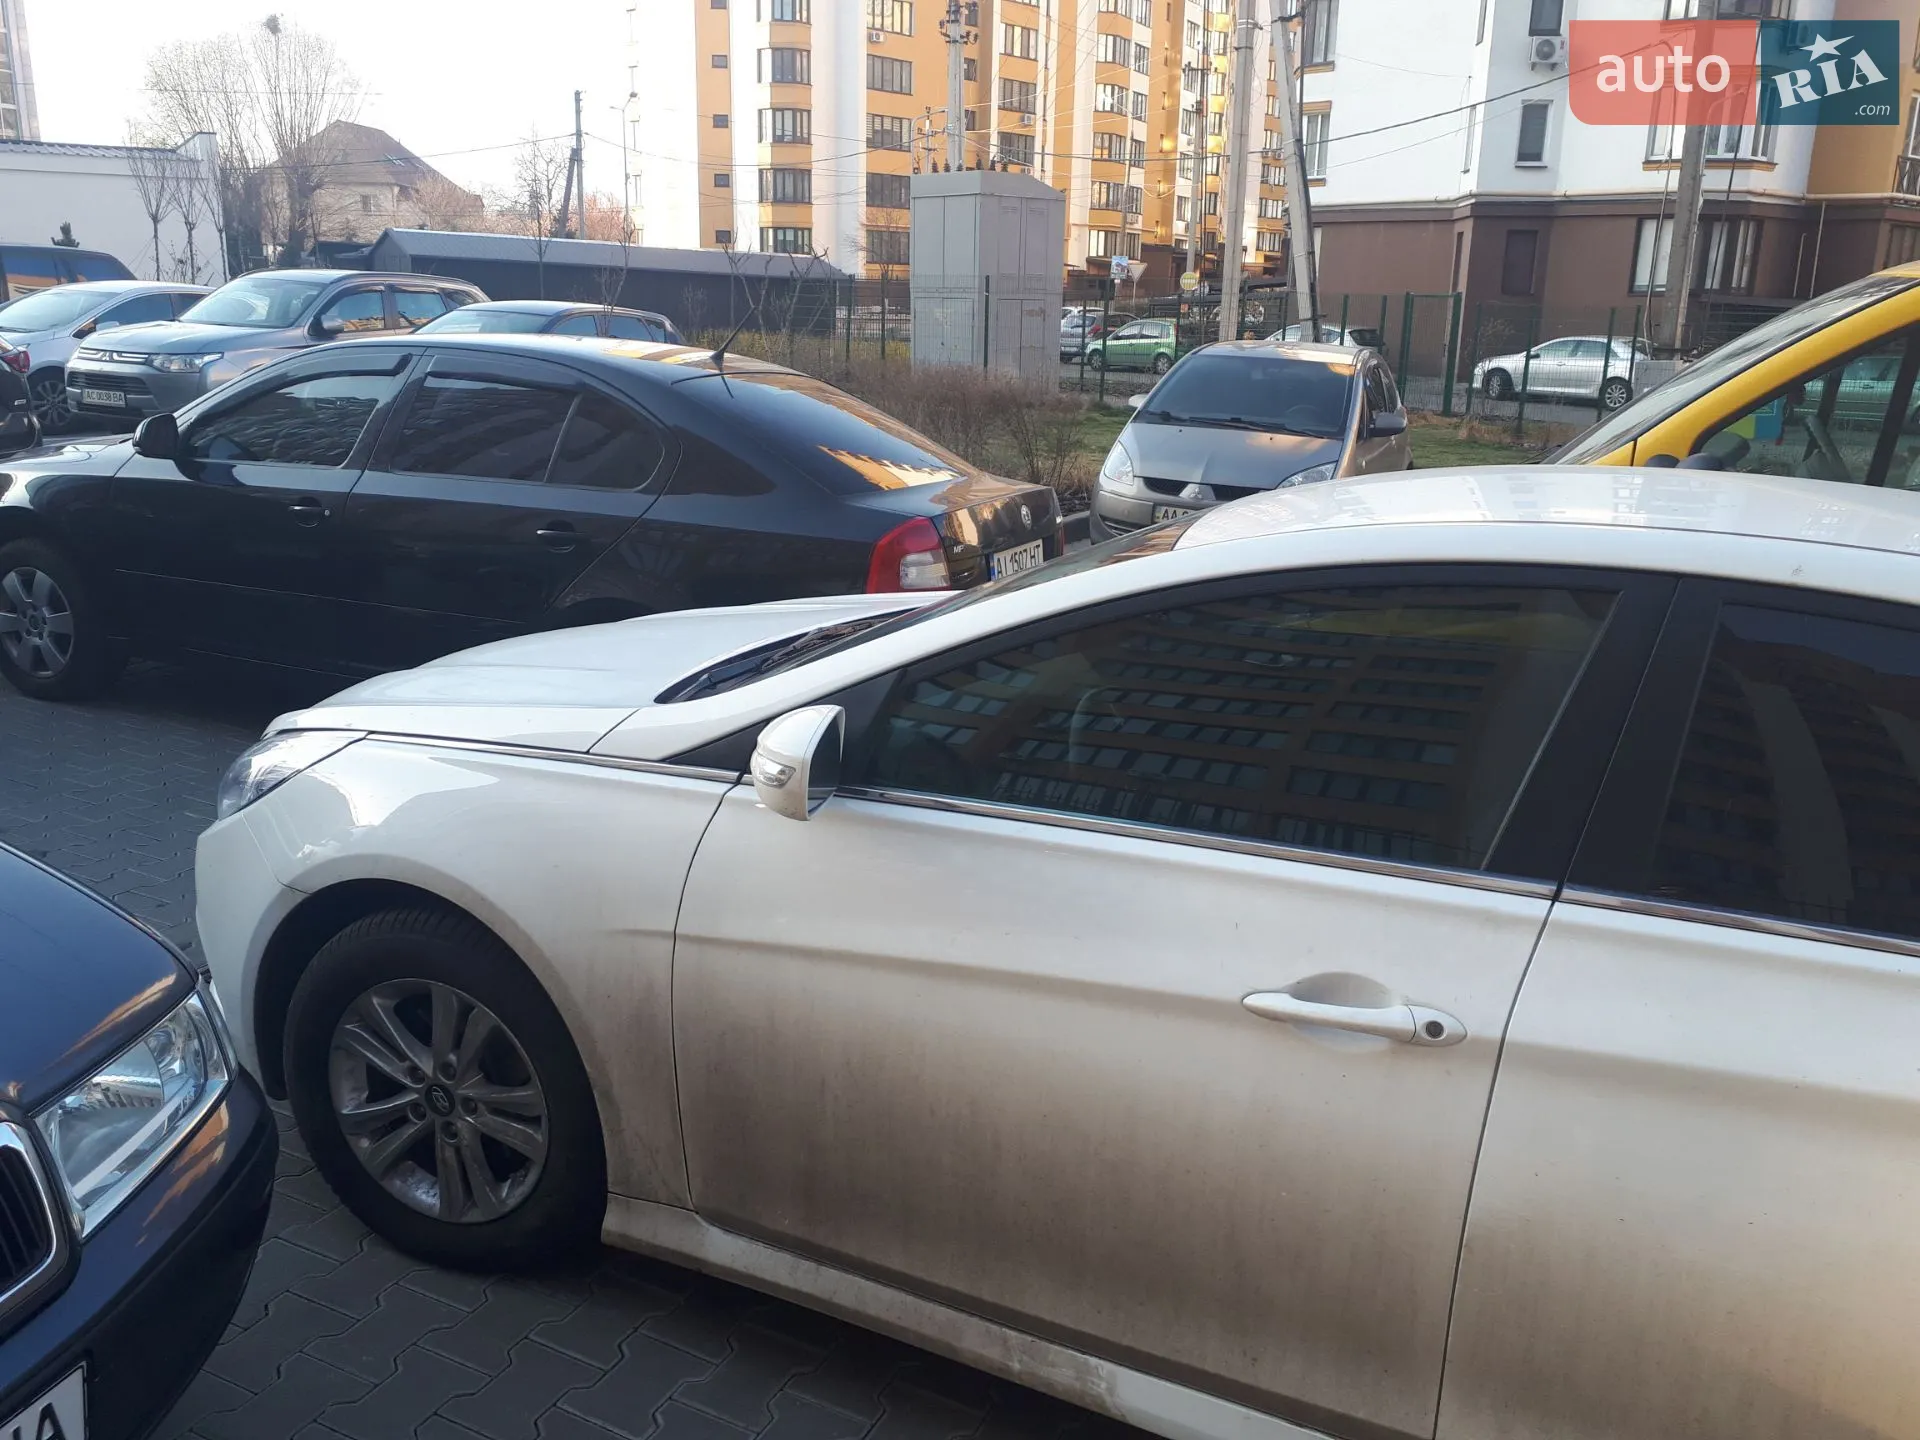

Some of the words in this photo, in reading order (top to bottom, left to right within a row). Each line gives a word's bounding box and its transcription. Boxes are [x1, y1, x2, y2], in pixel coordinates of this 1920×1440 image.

[1161, 507, 1178, 520] AA
[996, 553, 1008, 579] AI
[1009, 548, 1028, 573] 1507
[1029, 543, 1041, 568] HT
[11, 1402, 67, 1440] A
